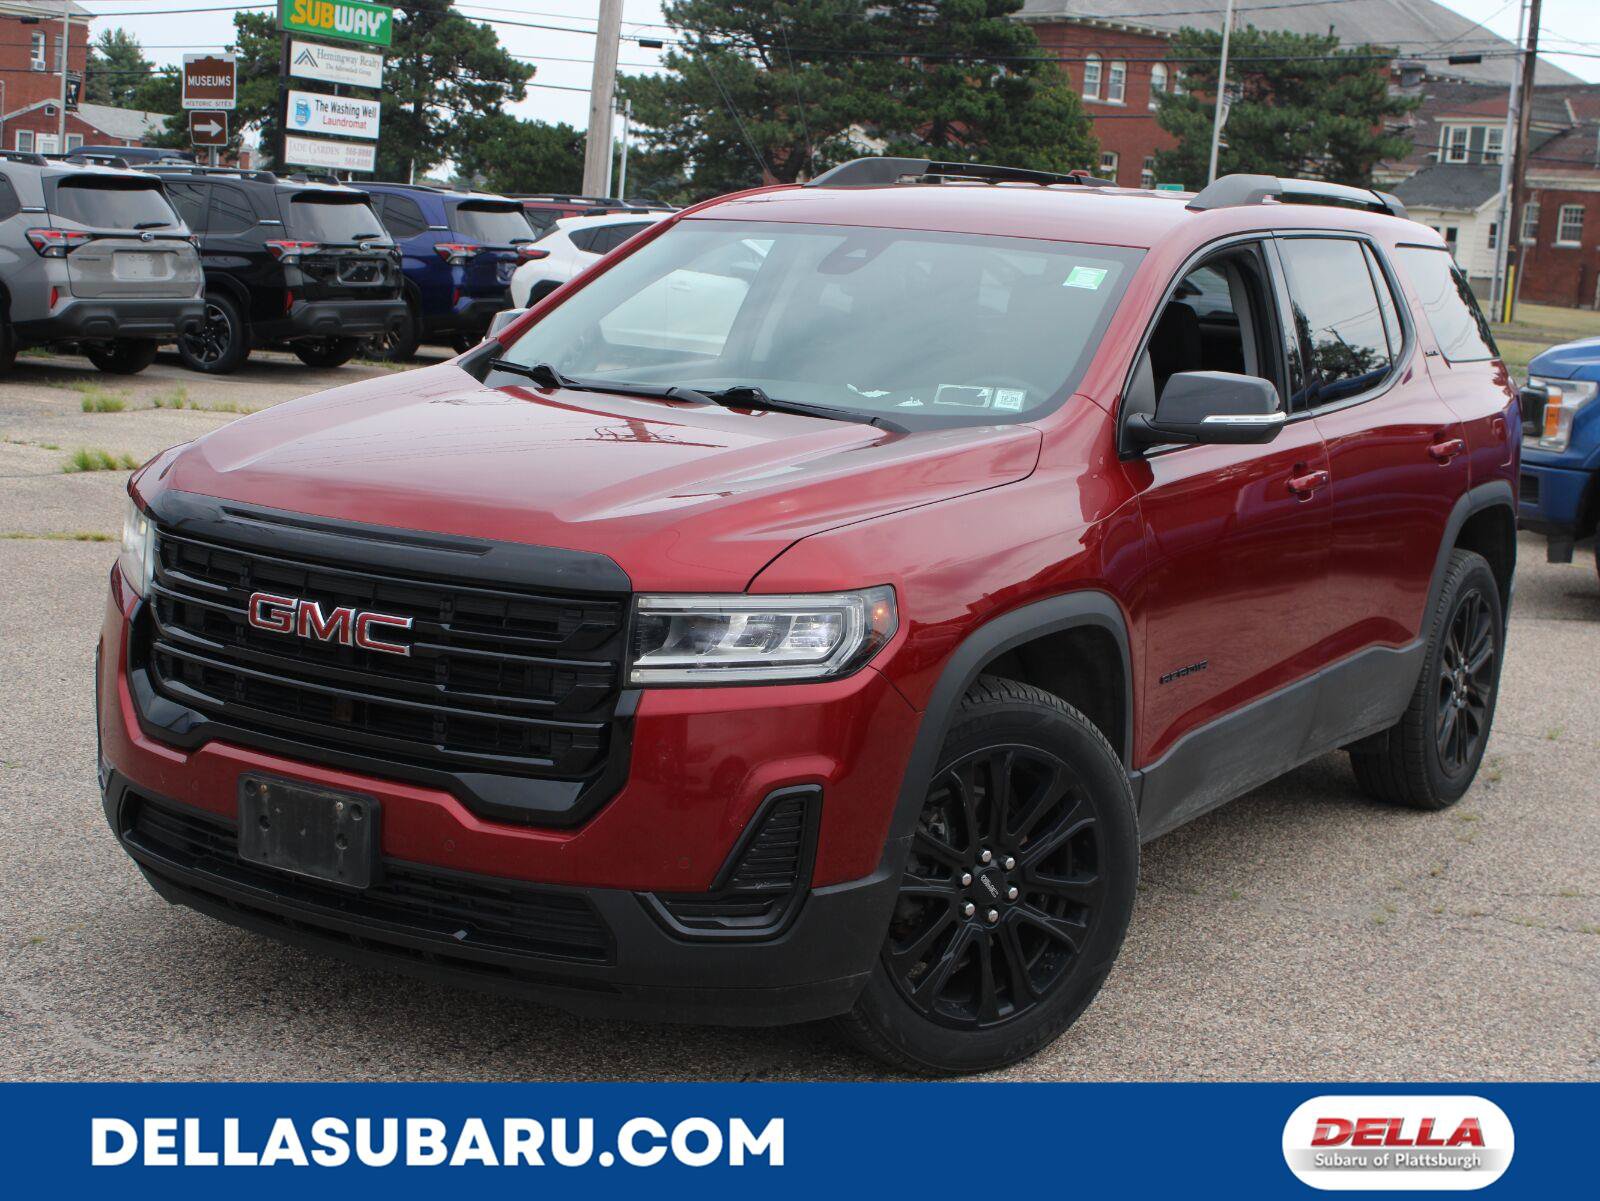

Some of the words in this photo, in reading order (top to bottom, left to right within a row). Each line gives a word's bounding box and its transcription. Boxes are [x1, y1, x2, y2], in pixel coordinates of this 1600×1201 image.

[290, 0, 388, 37] SUBWAY
[316, 48, 359, 64] Hemingway
[360, 55, 380, 69] Realty
[187, 75, 231, 86] MUSEUMS
[315, 99, 328, 112] The
[330, 102, 360, 118] Washing
[362, 106, 377, 118] Well
[323, 115, 367, 128] Laundromat
[248, 592, 414, 657] GMC
[980, 874, 999, 898] GMC
